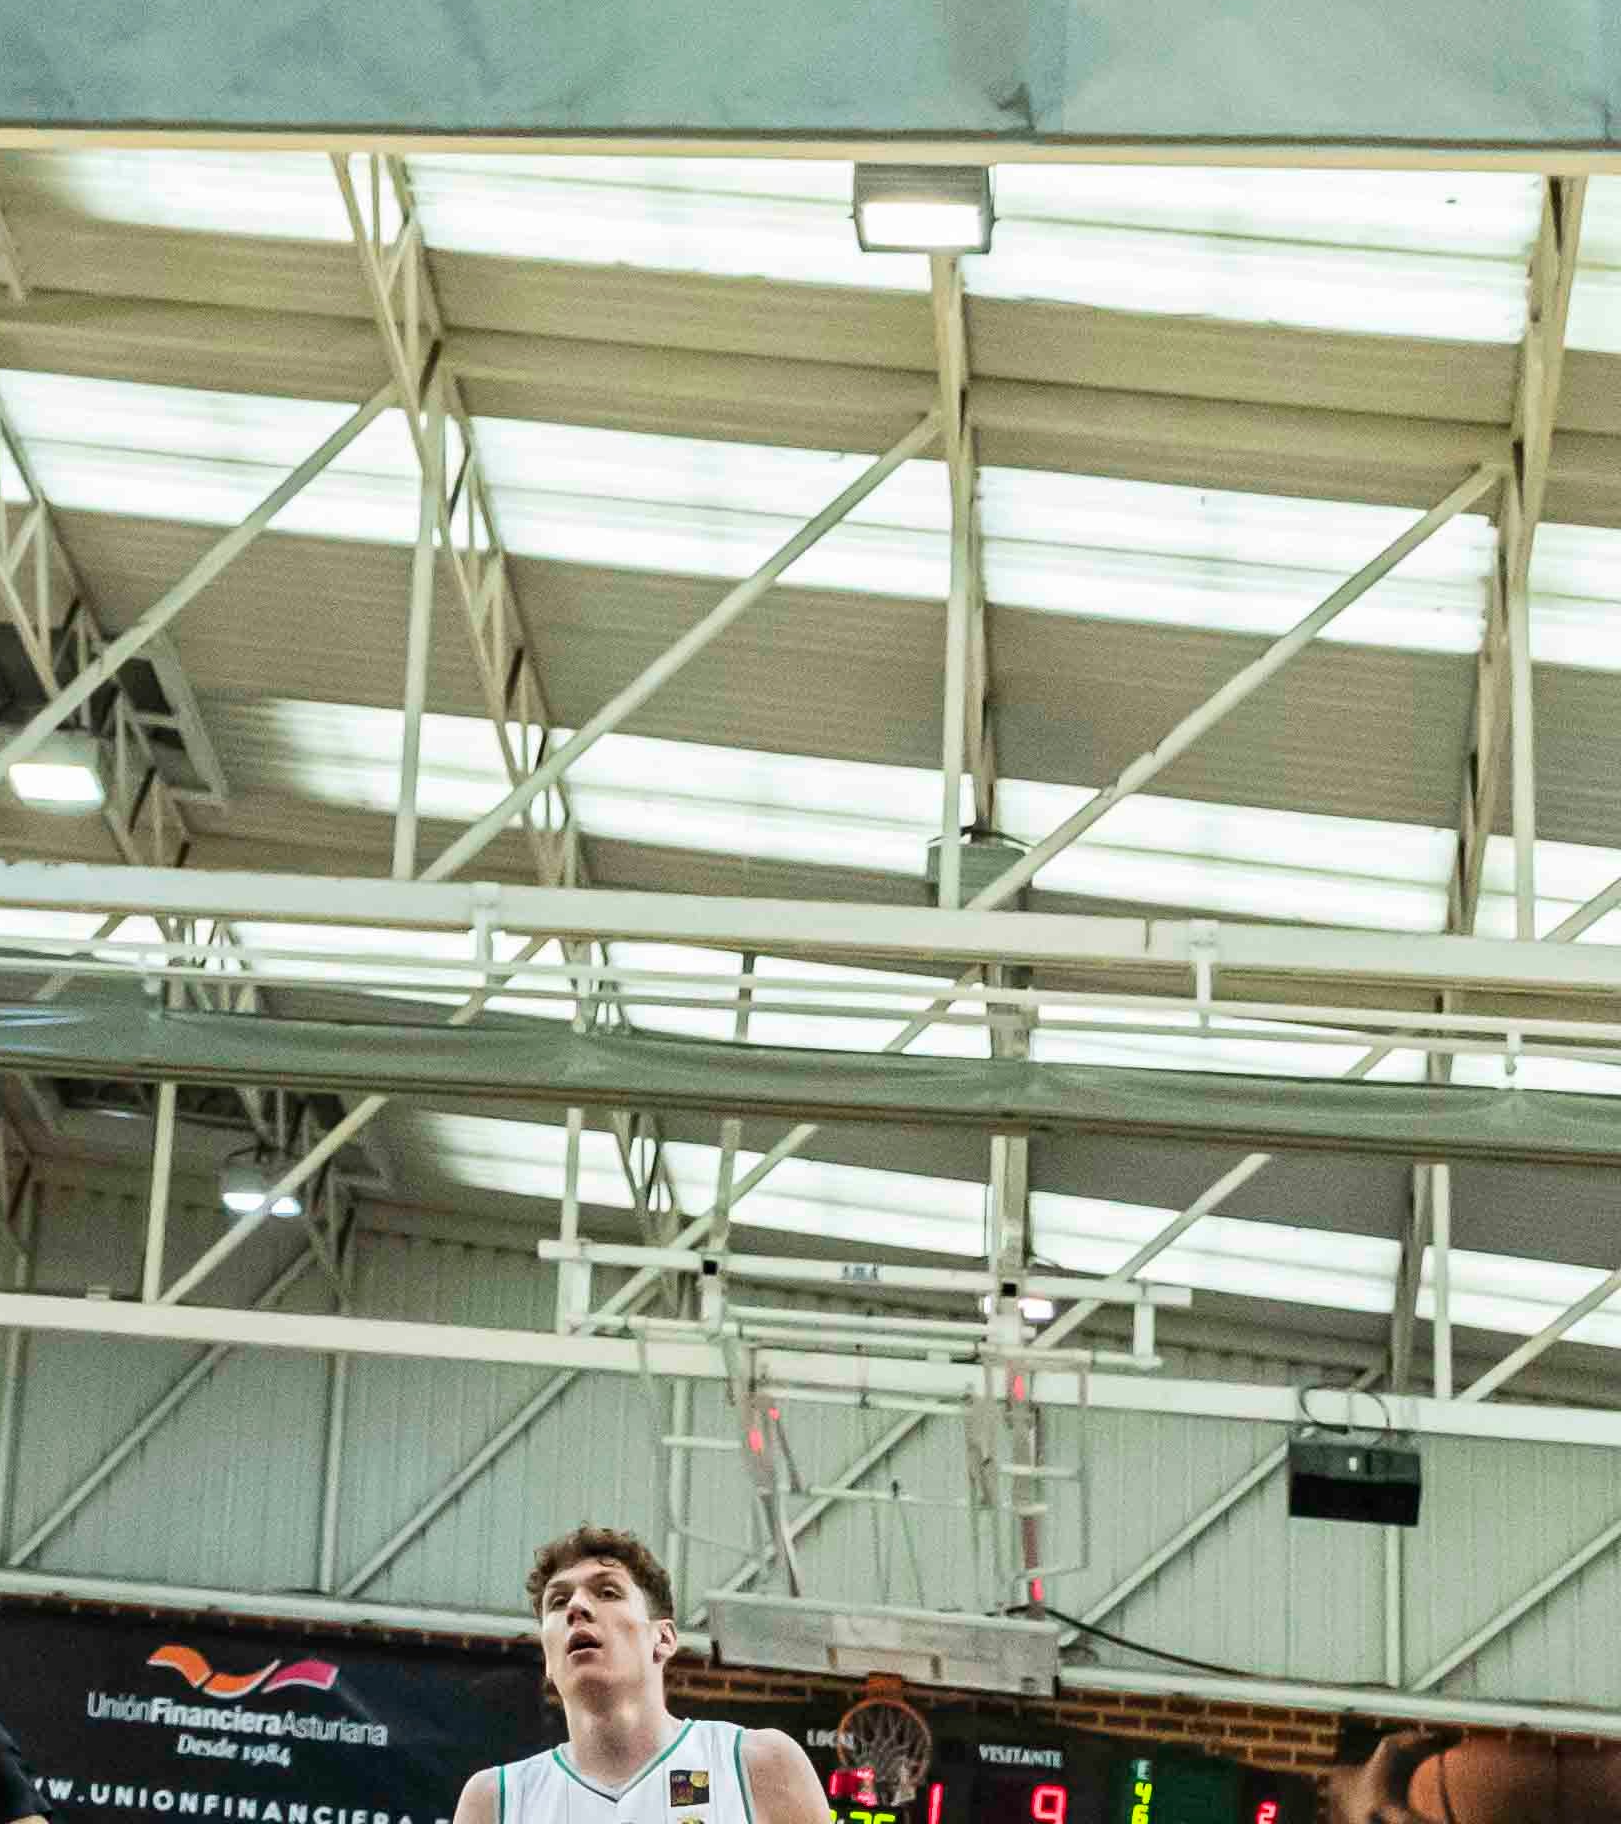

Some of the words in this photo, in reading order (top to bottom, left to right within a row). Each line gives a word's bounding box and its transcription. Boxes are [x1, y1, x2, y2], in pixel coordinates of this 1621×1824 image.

[177, 1733, 238, 1760] Desde
[243, 1744, 293, 1769] 1984
[806, 1728, 857, 1750] LOCA
